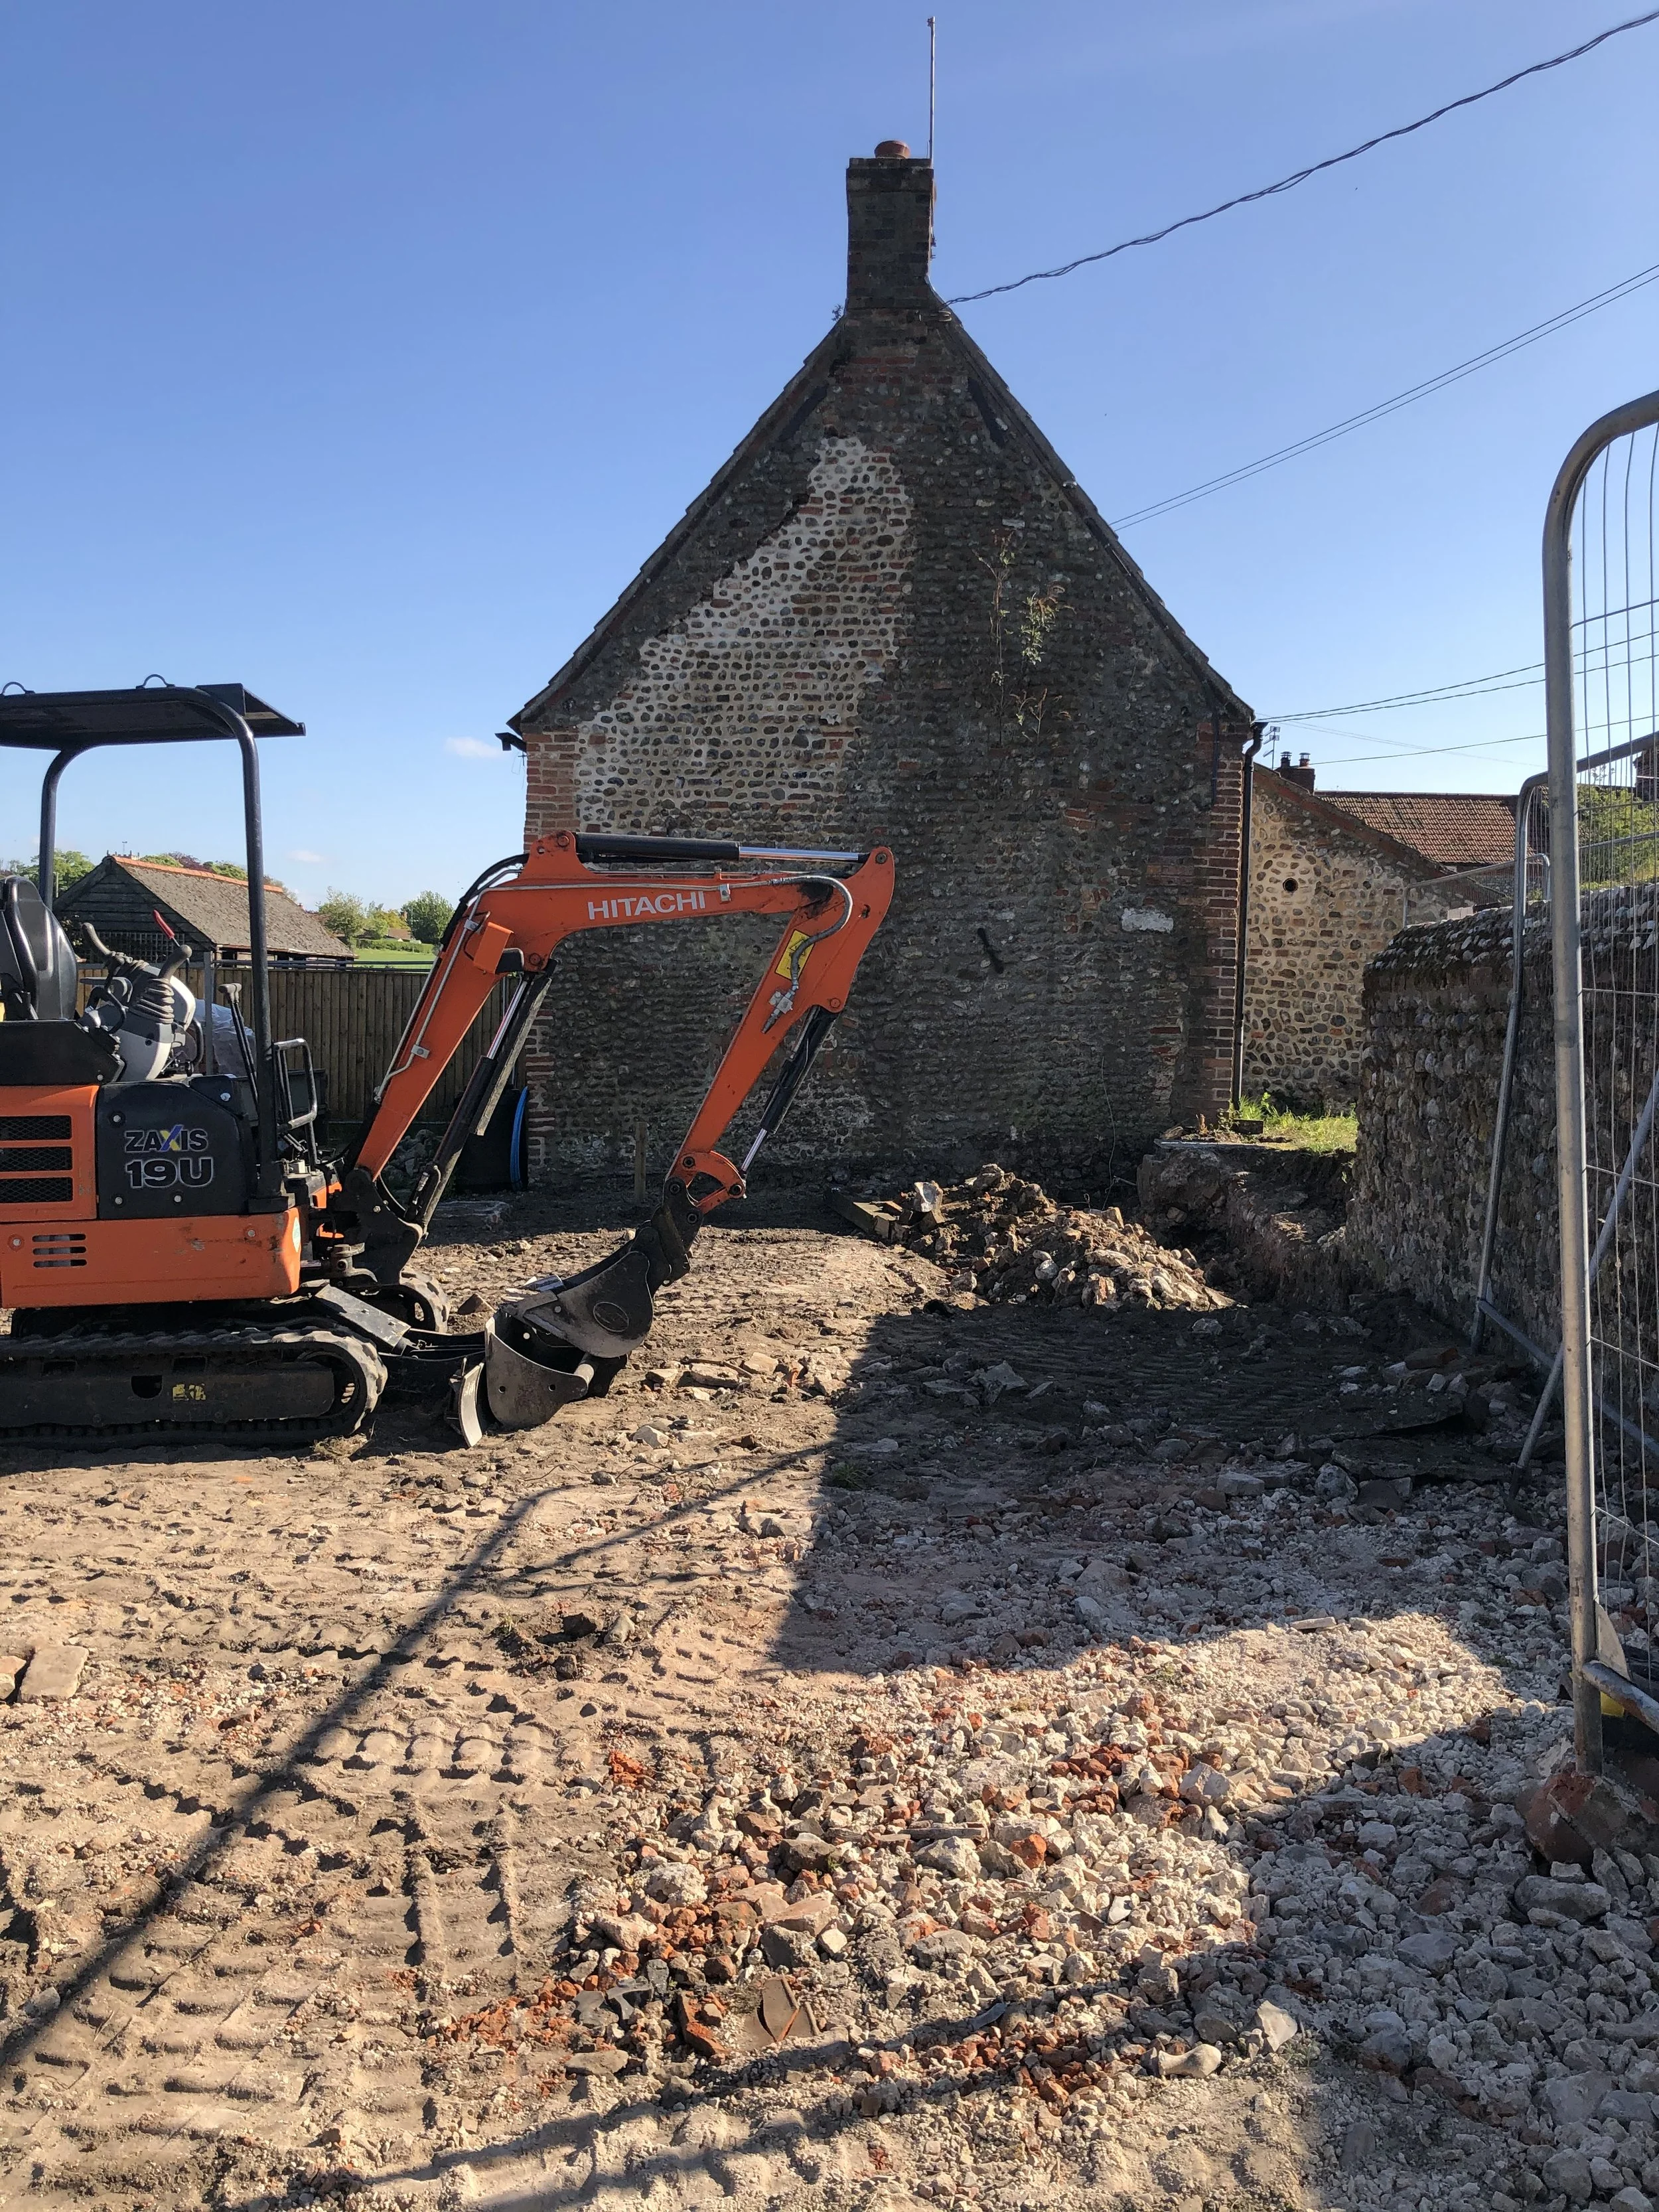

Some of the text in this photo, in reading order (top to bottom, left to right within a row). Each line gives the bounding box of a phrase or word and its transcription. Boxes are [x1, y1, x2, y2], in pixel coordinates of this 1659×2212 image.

[587, 891, 705, 920] HITACHI
[125, 1124, 208, 1152] ZAXIS
[125, 1157, 214, 1189] 19U
